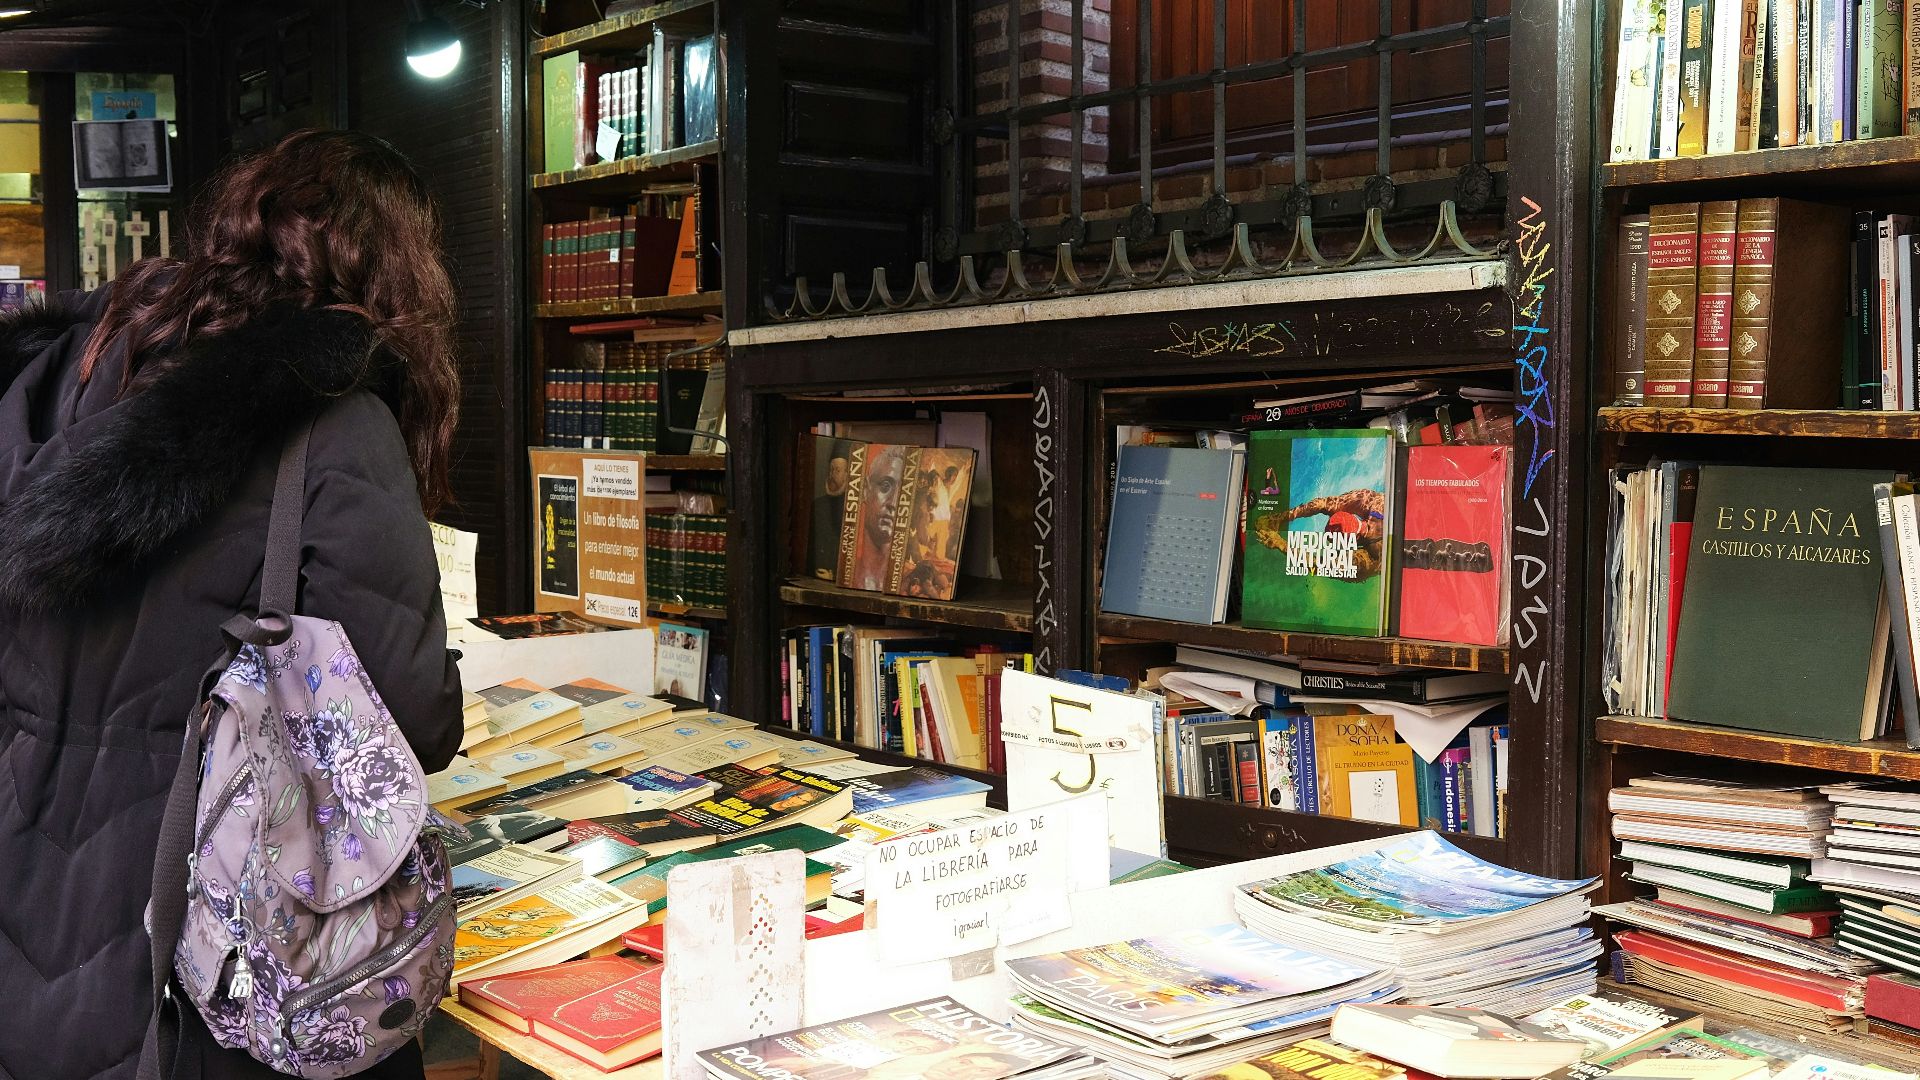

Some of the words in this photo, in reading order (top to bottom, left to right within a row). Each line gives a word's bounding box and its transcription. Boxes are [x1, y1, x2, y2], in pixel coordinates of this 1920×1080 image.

[1757, 22, 1765, 35] ON
[1756, 36, 1764, 51] THE
[1755, 53, 1763, 80] BEACH
[1858, 223, 1869, 231] 35
[1653, 238, 1691, 247] DICCIONARIO
[1265, 406, 1282, 422] 20
[1284, 405, 1300, 416] AÑOS
[1300, 404, 1309, 414] DE
[1311, 400, 1347, 413] DEMOCRACIA
[613, 464, 630, 474] TIENES
[568, 485, 576, 494] del
[615, 477, 633, 486] vendido
[845, 446, 866, 523] ESPAÑA
[896, 450, 919, 528] ESPAÑA
[1127, 476, 1139, 486] Siglo
[1415, 478, 1425, 488] LOS
[1425, 478, 1449, 488] TIEMPOS
[1449, 478, 1480, 488] FABULADOS
[583, 511, 592, 525] Un
[592, 511, 607, 528] libro
[607, 513, 616, 528] de
[615, 513, 640, 531] filosofía
[1717, 506, 1861, 538] ESPAÑA
[1901, 503, 1912, 541] Colección
[841, 525, 850, 554] GRAN
[891, 530, 901, 560] GRAN
[1287, 531, 1358, 551] MEDICINA
[584, 541, 598, 556] para
[598, 542, 622, 556] entender
[622, 544, 640, 561] mejor
[843, 538, 855, 585] HISTORIA
[1286, 549, 1358, 570] NATURAL
[1702, 539, 1772, 559] CASTILLOS
[1774, 543, 1786, 560] Y
[1788, 544, 1870, 566] ALCAZARES
[589, 566, 595, 580] el
[595, 567, 616, 583] mundo
[616, 570, 636, 585] actual
[890, 544, 904, 592] HISTORIA
[1285, 566, 1309, 577] SALUD
[1309, 567, 1316, 577] Y
[1316, 568, 1358, 579] BIENESTAR
[627, 605, 639, 618] 12€
[1303, 721, 1312, 754] LECTORES
[1304, 755, 1312, 765] DE
[1334, 761, 1343, 769] EL
[1343, 761, 1366, 769] TRUENO
[1376, 760, 1385, 768] LA
[1385, 759, 1410, 768] CIUDAD
[720, 797, 753, 812] Vida
[746, 808, 770, 819] de
[879, 845, 897, 863] NO
[908, 833, 961, 857] OCUPAR
[969, 820, 1018, 844] ESPACIO
[1030, 815, 1045, 830] DE
[895, 870, 912, 890] LA
[1008, 839, 1038, 862] PARA
[1417, 840, 1583, 892] VIAJES
[936, 873, 1027, 911] FOTOGRAFIARSE
[1215, 927, 1373, 983] VIAJES
[1054, 976, 1166, 1012] PARIS
[914, 999, 1071, 1064] HISTORIA
